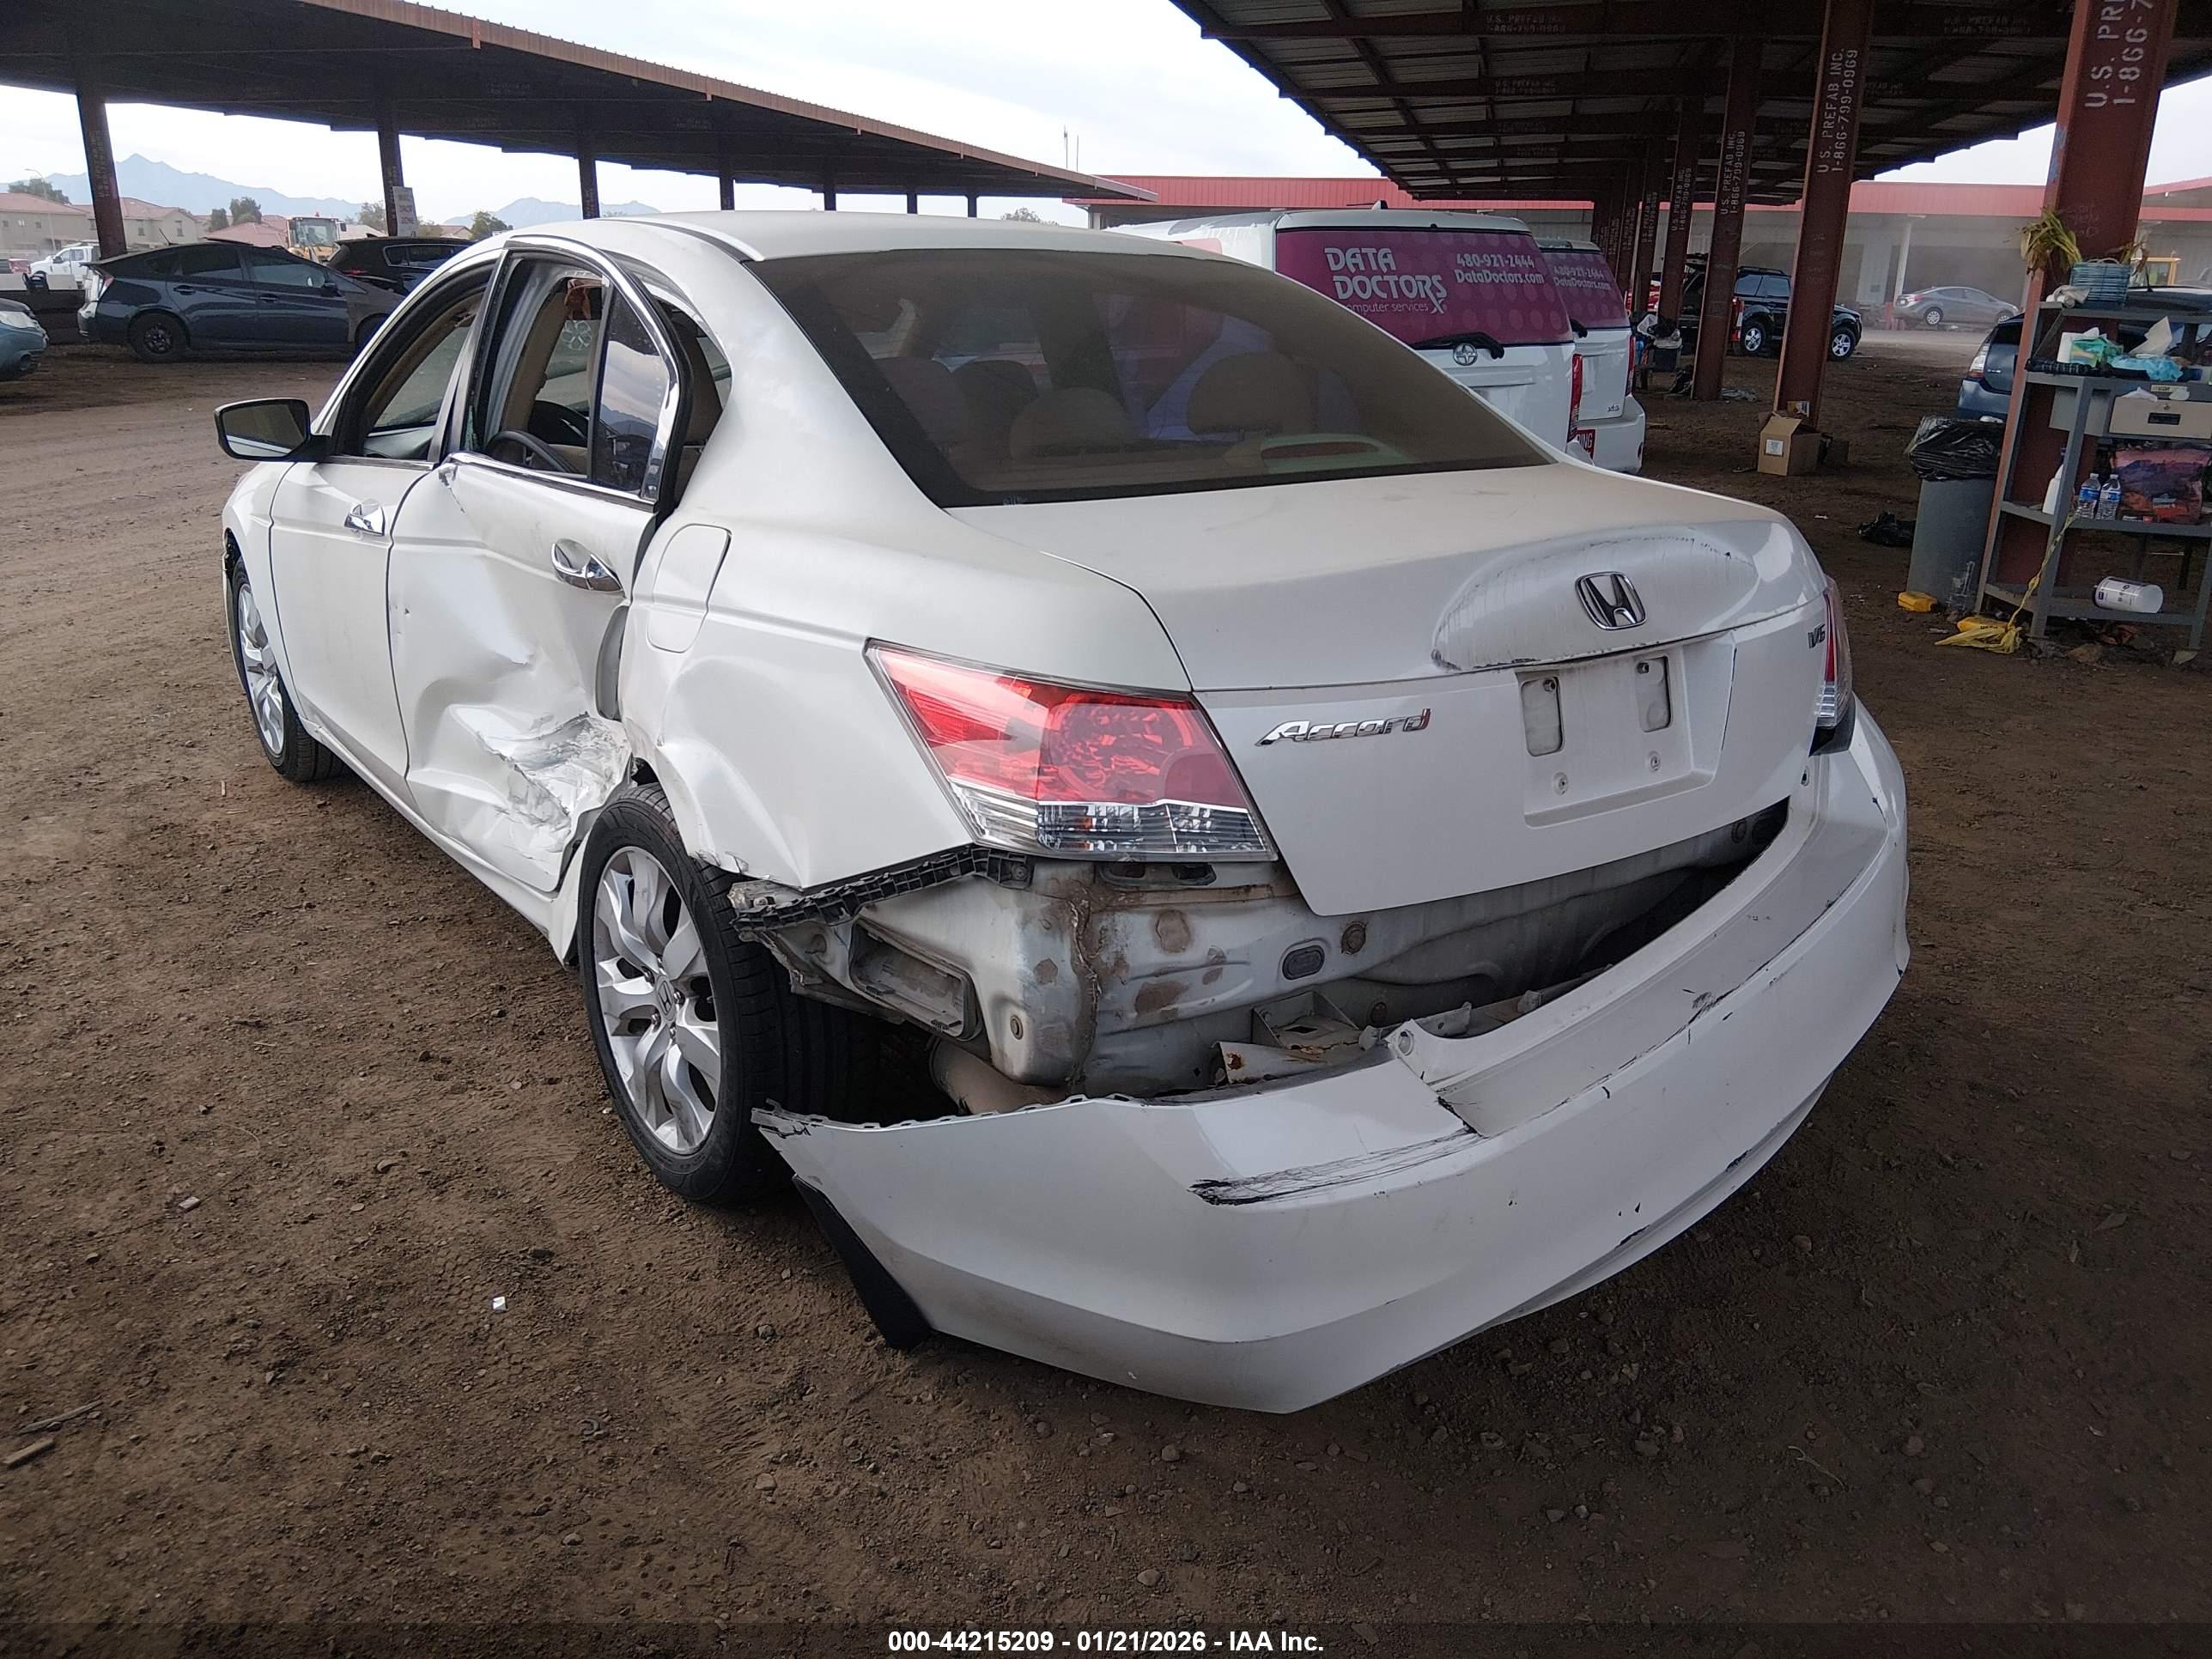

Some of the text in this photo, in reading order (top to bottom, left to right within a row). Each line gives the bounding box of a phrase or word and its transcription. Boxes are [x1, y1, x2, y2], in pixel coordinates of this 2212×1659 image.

[1829, 48, 1844, 76] INC.
[2084, 0, 2125, 107] U.S. PR
[1821, 82, 1839, 138] PREFAB
[1831, 49, 1858, 173] 1-866-799-0969
[1324, 247, 1396, 274] DATA
[1457, 254, 1534, 268] 480-921-2444
[1455, 269, 1545, 283] DataDoctors.com
[1346, 302, 1429, 315] omputer services
[1807, 623, 1826, 649] V6
[1255, 708, 1431, 746] Accord
